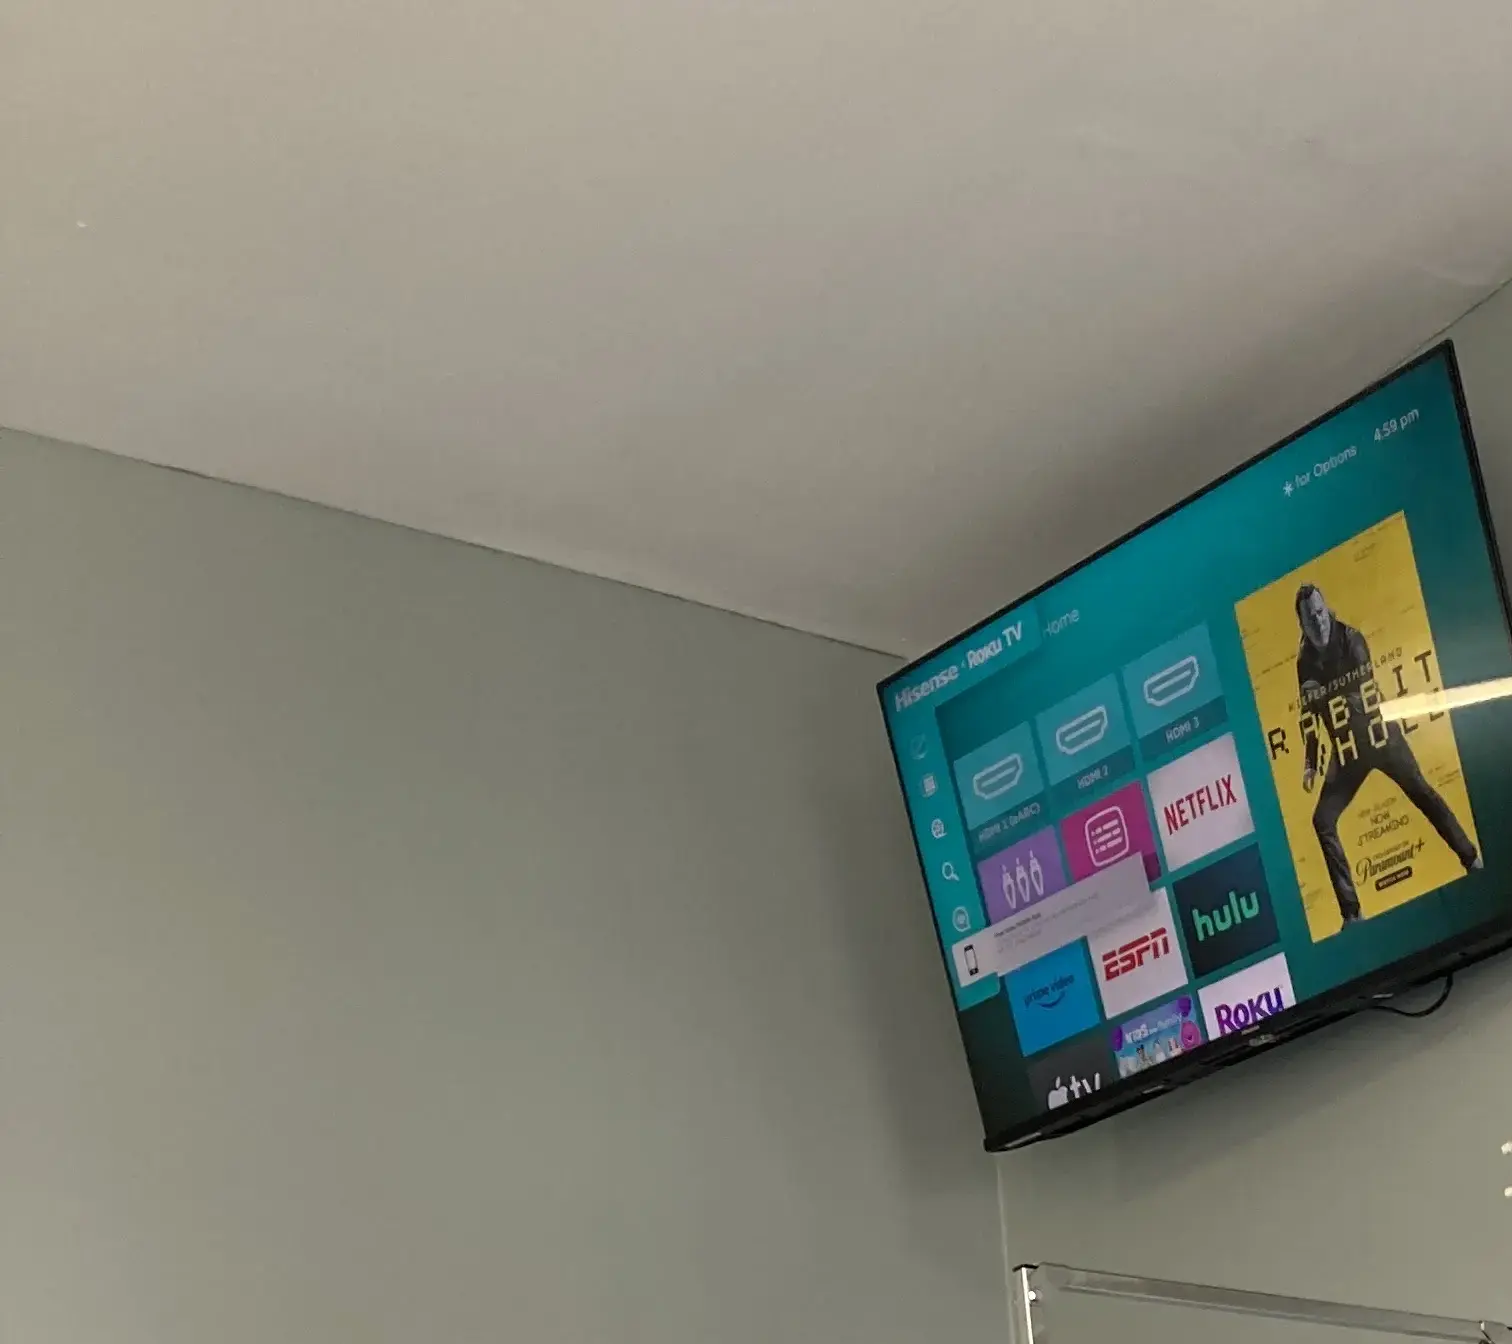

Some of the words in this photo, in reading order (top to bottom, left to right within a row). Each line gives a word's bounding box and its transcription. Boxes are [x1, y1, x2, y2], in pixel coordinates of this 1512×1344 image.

[1400, 409, 1419, 430] pm
[896, 666, 960, 712] Hisense
[1003, 621, 1023, 646] TV
[1267, 650, 1432, 760] RABBIT
[1164, 774, 1237, 835] NETFLIX
[1192, 890, 1260, 941] hulu
[1102, 927, 1170, 981] ESPN
